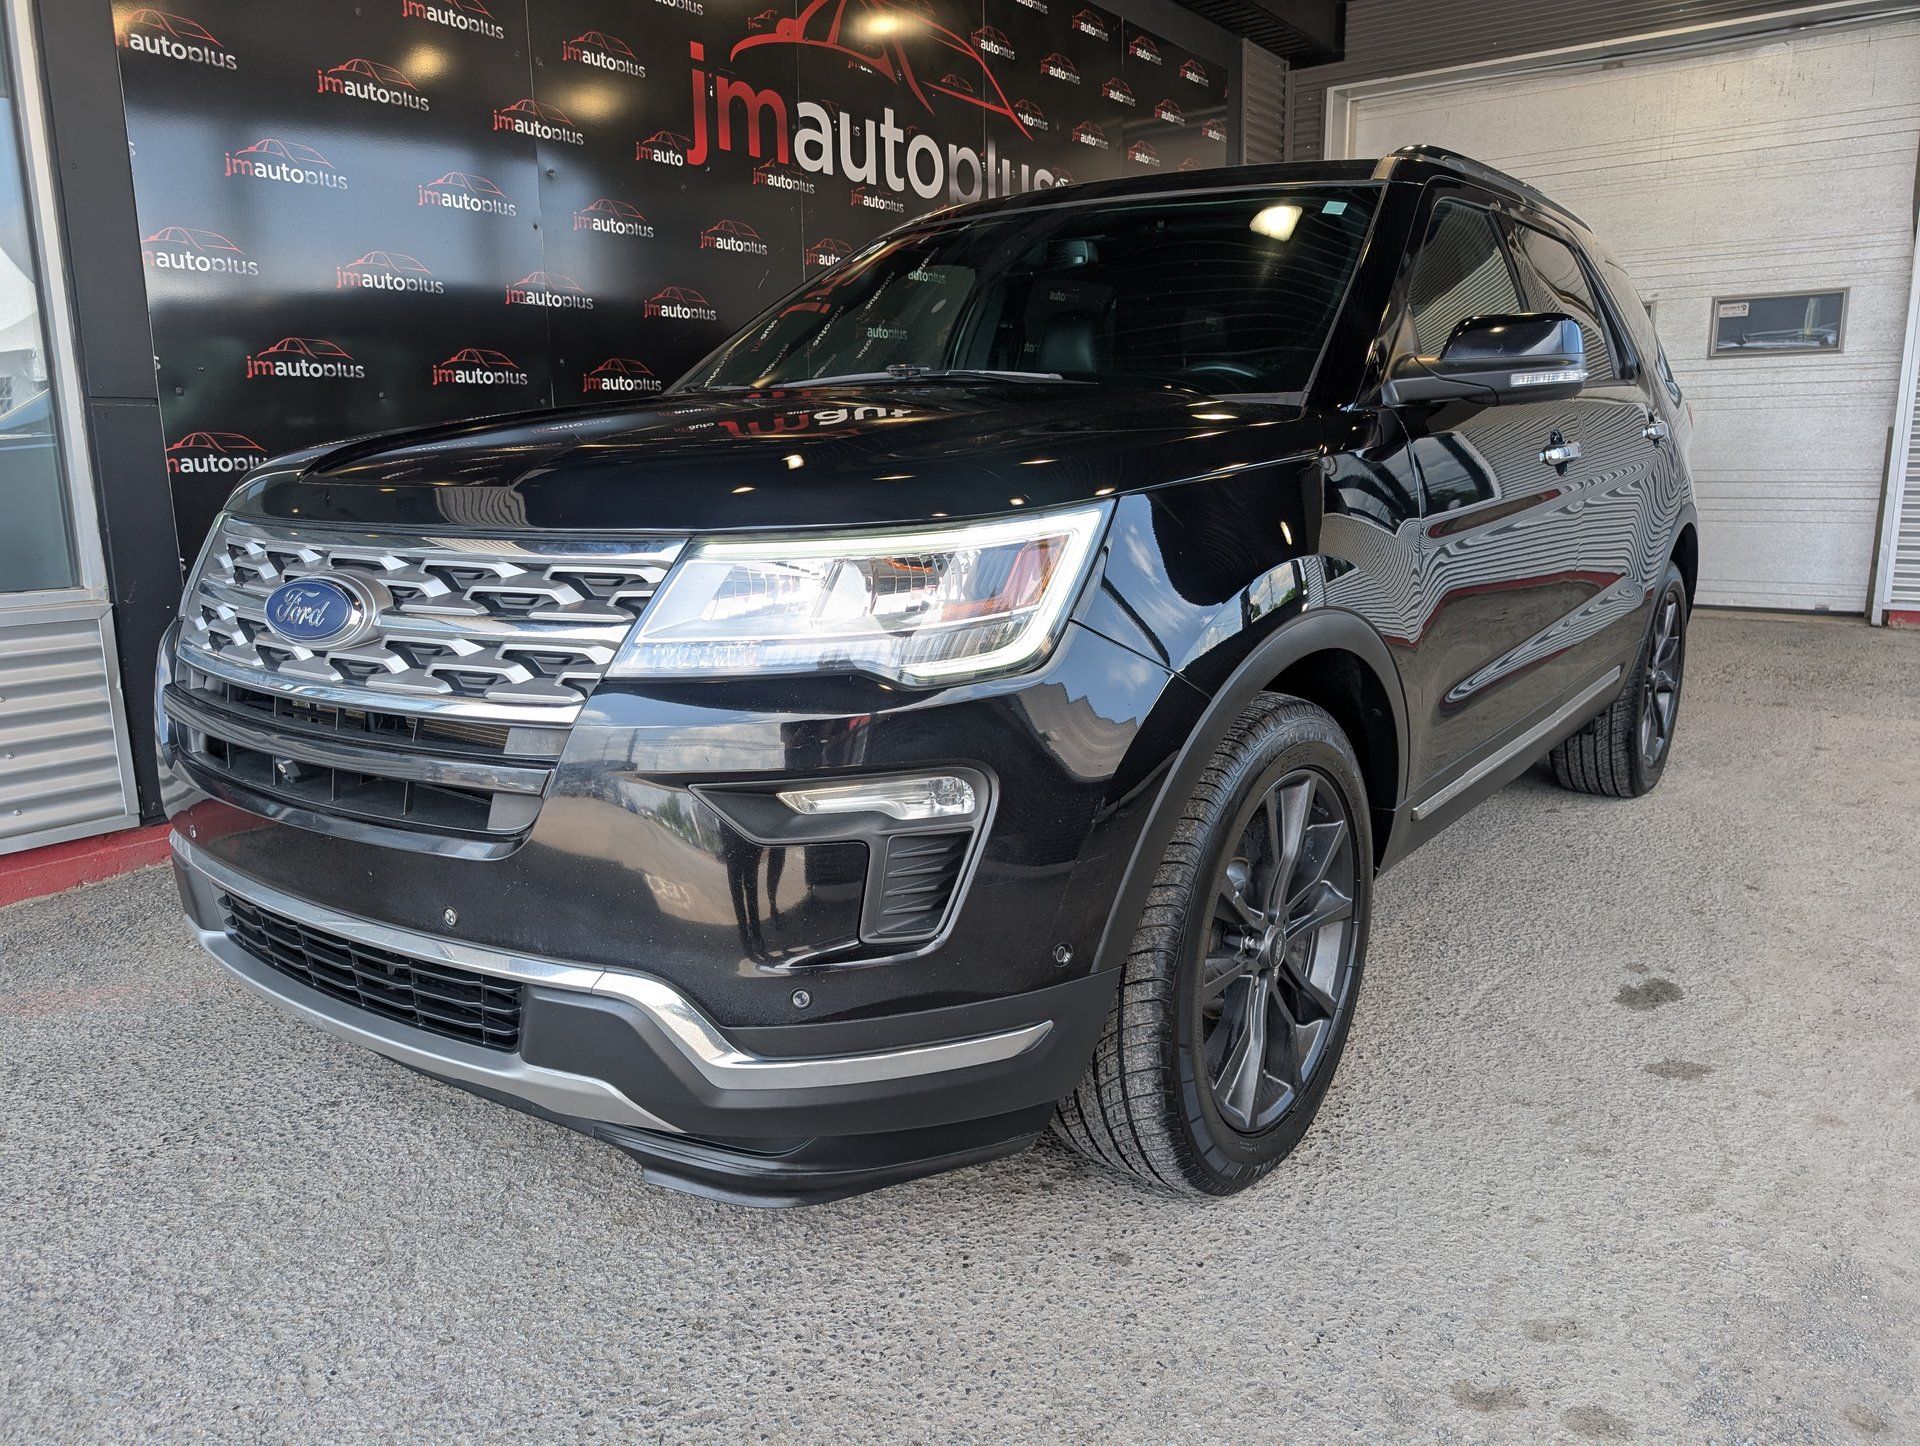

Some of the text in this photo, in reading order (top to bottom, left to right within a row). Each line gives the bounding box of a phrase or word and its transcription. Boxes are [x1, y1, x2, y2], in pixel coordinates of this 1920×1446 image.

[402, 0, 504, 39] jmautoplus
[562, 40, 646, 79] jmautoplus
[317, 69, 430, 112] jmautoplus
[493, 109, 584, 146] jmautoplus
[636, 142, 684, 167] jmauto
[225, 152, 348, 190] jmautoplus
[752, 168, 815, 195] jmautoplus
[418, 185, 516, 217] jmautoplus
[850, 189, 904, 213] jmautoplus
[573, 211, 654, 239] jmautoplus
[700, 231, 767, 256] jmautoplus
[336, 267, 444, 295] jmautoplus
[505, 285, 594, 310] jmautoplus
[643, 301, 717, 321] jmautoplus
[246, 355, 365, 379] jmautoplus
[432, 364, 528, 386] jmautoplus
[583, 373, 662, 393] jmautoplus
[276, 588, 331, 628] Ford
